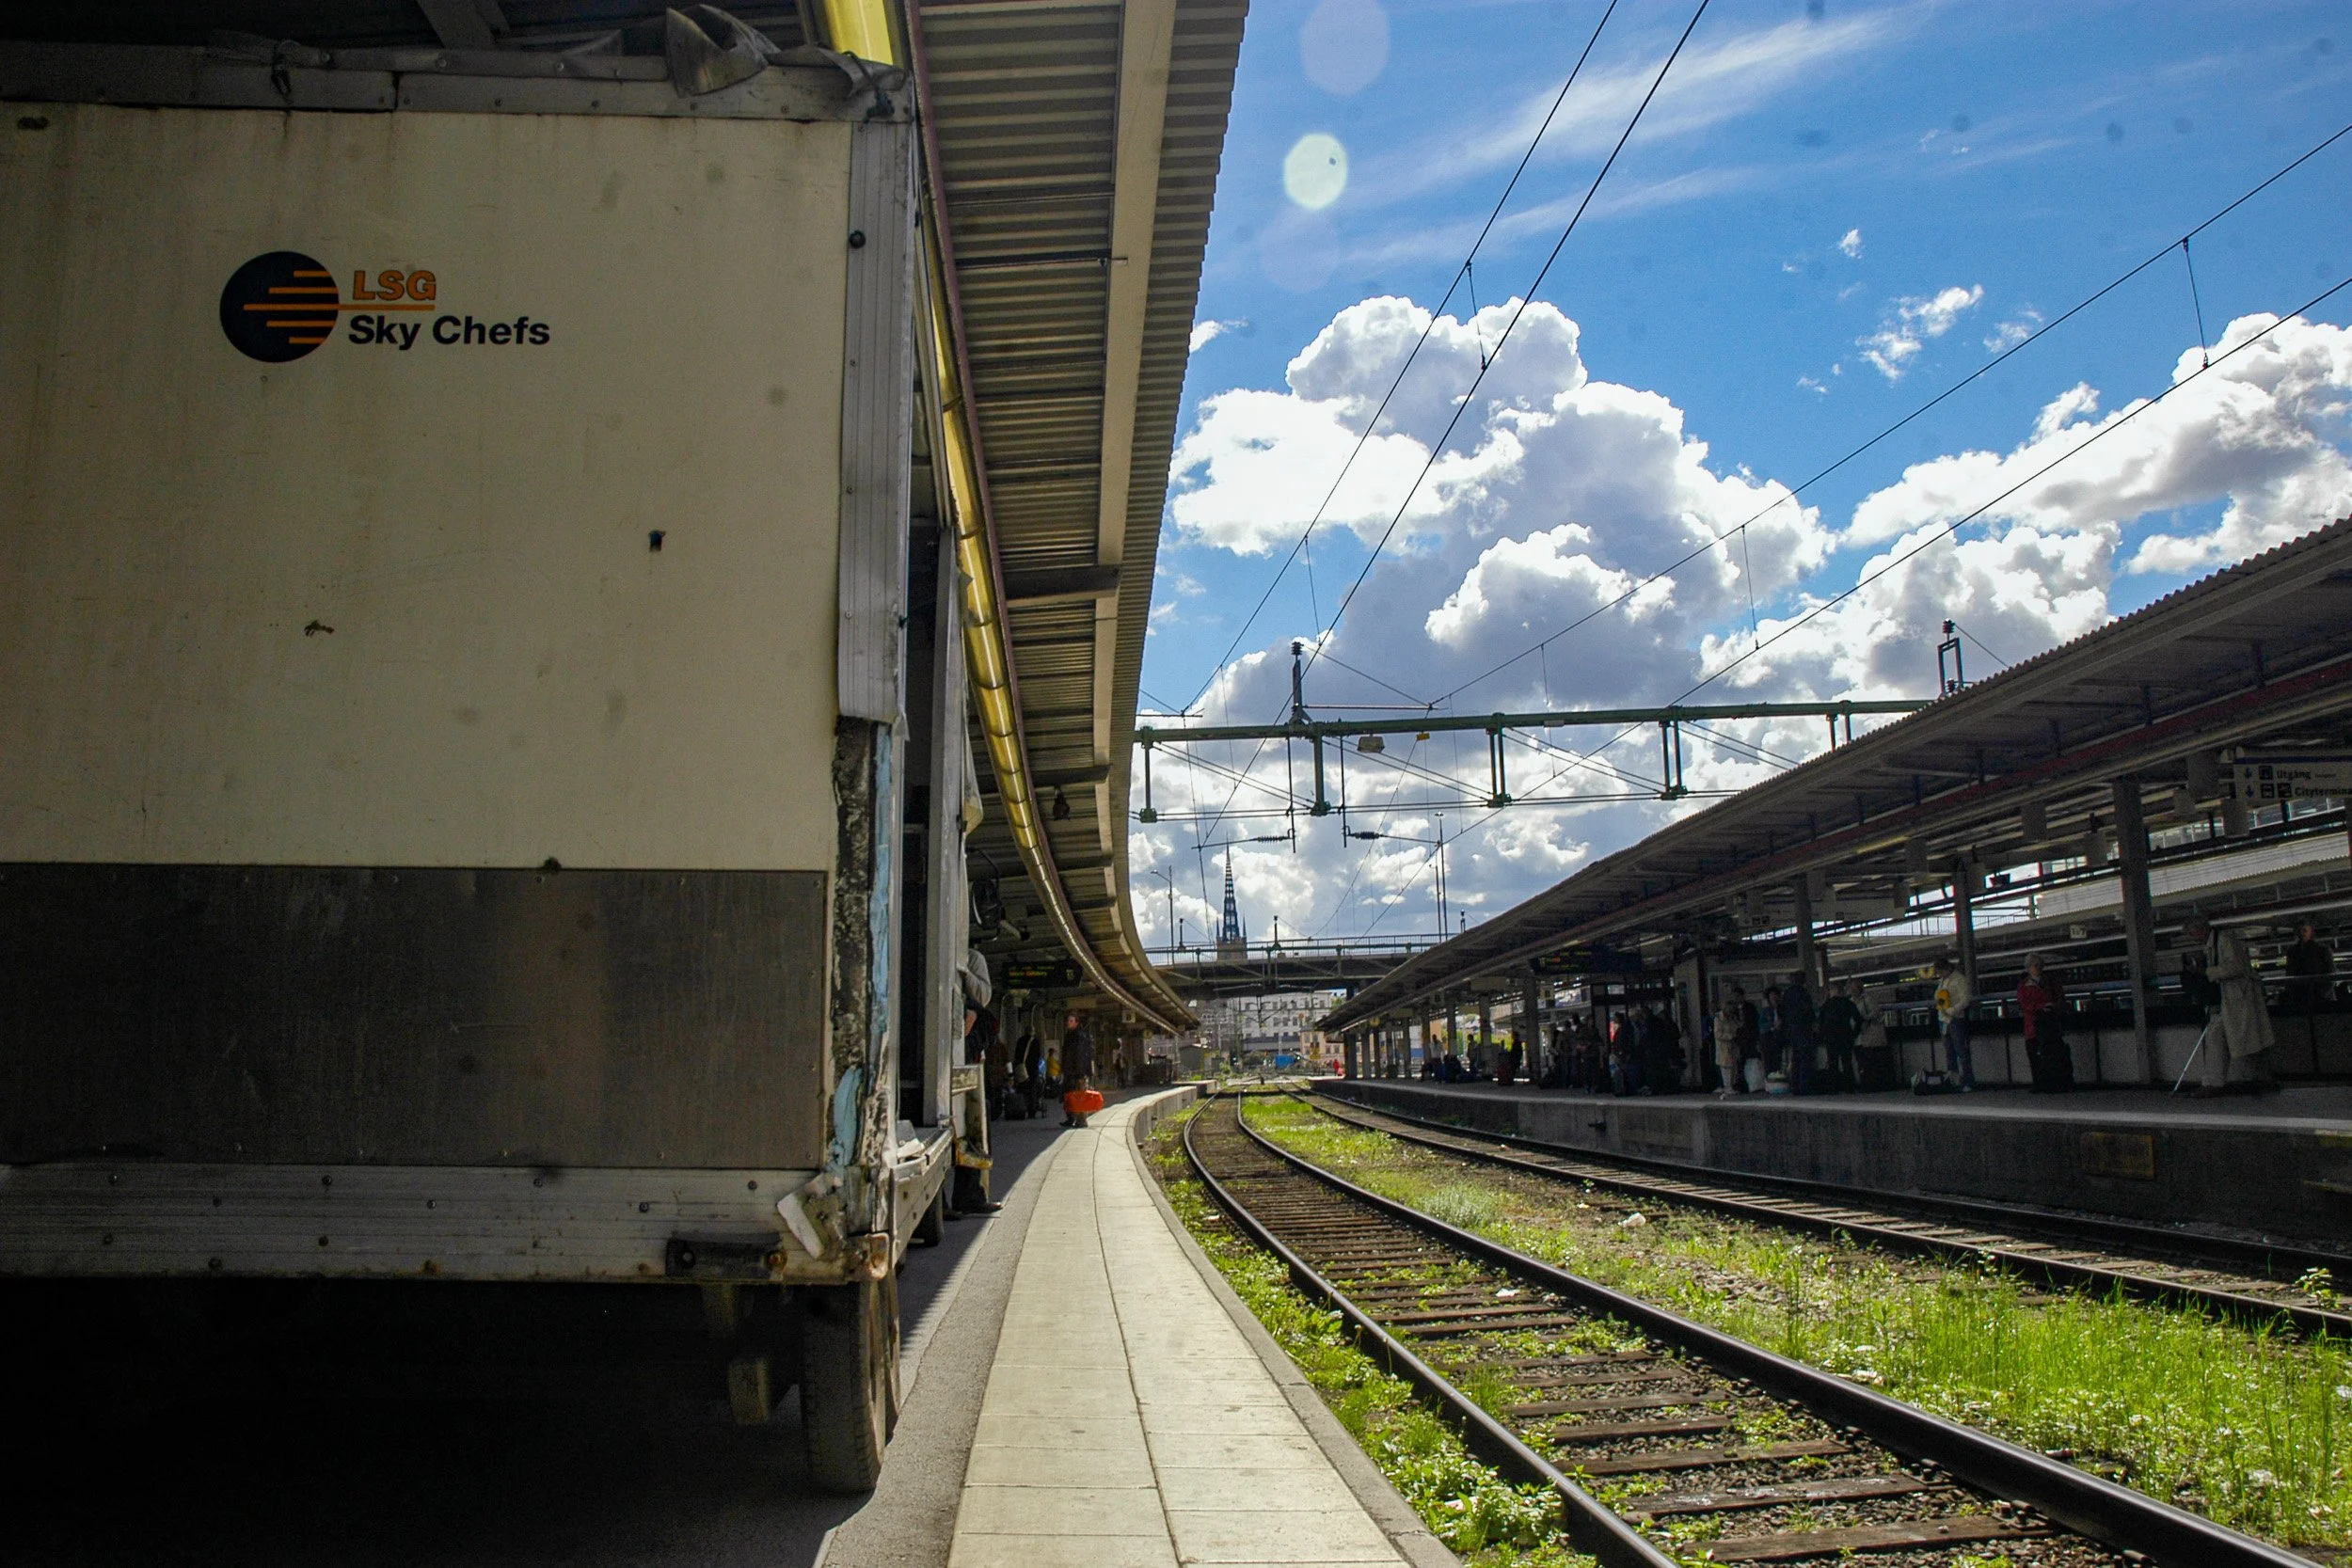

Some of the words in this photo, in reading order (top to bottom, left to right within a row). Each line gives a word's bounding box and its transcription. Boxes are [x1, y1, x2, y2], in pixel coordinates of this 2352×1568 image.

[352, 269, 437, 302] LSG
[348, 314, 421, 351] Sky
[432, 314, 550, 346] Chefs
